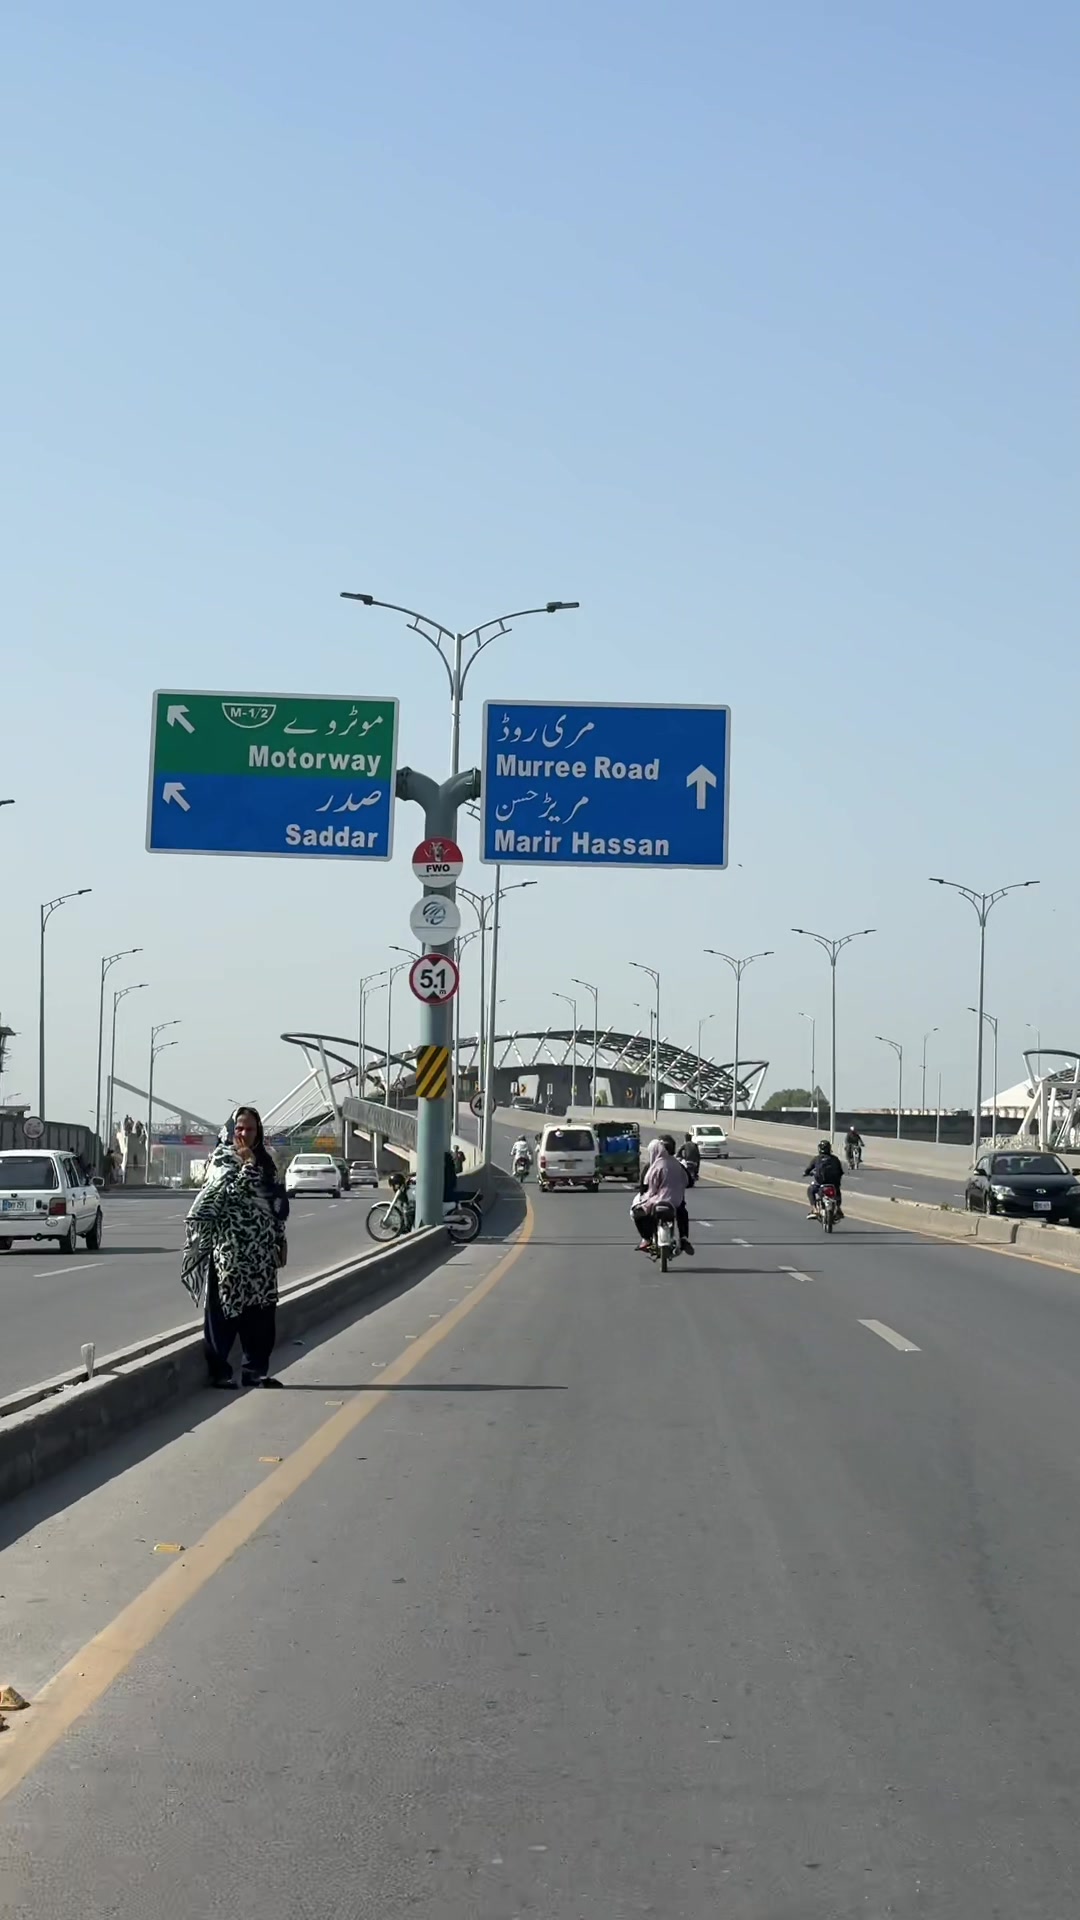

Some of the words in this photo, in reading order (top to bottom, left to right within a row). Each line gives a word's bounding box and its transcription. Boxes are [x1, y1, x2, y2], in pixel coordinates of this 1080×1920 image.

[230, 707, 269, 719] M-1/2
[497, 712, 538, 742] روڈ
[542, 713, 595, 749] مری
[248, 745, 382, 777] Motorway
[496, 754, 587, 778] Murree
[594, 756, 660, 781] Road
[315, 790, 382, 813] صدر
[495, 790, 539, 822] حسن
[285, 823, 379, 848] Saddar
[494, 829, 562, 854] Marir
[572, 831, 670, 856] Hassan
[426, 864, 450, 873] FWO
[420, 968, 446, 989] 5.1
